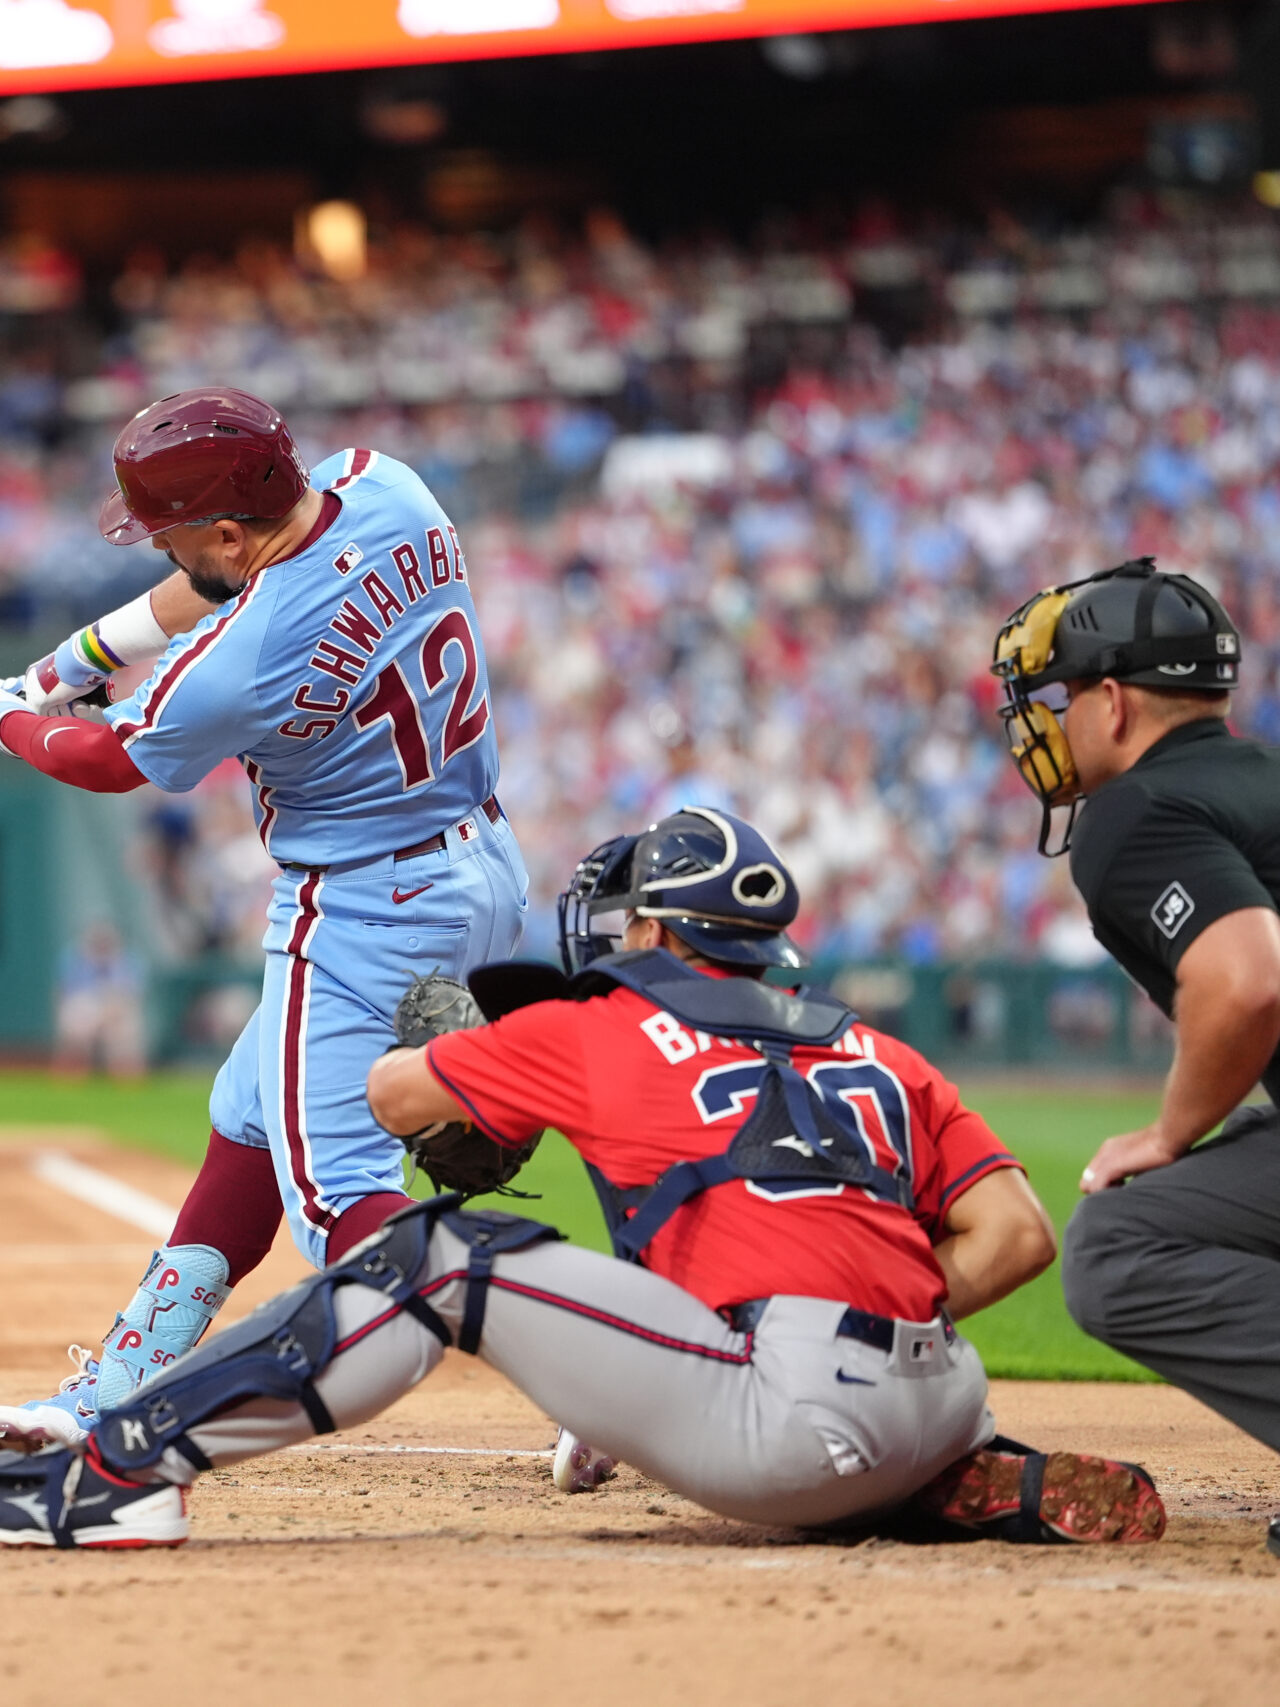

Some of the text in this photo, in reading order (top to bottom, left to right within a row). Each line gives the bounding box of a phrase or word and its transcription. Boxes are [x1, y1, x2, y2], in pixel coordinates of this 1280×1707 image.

[350, 606, 490, 792] 12
[156, 1268, 180, 1291] P
[116, 1329, 142, 1351] P
